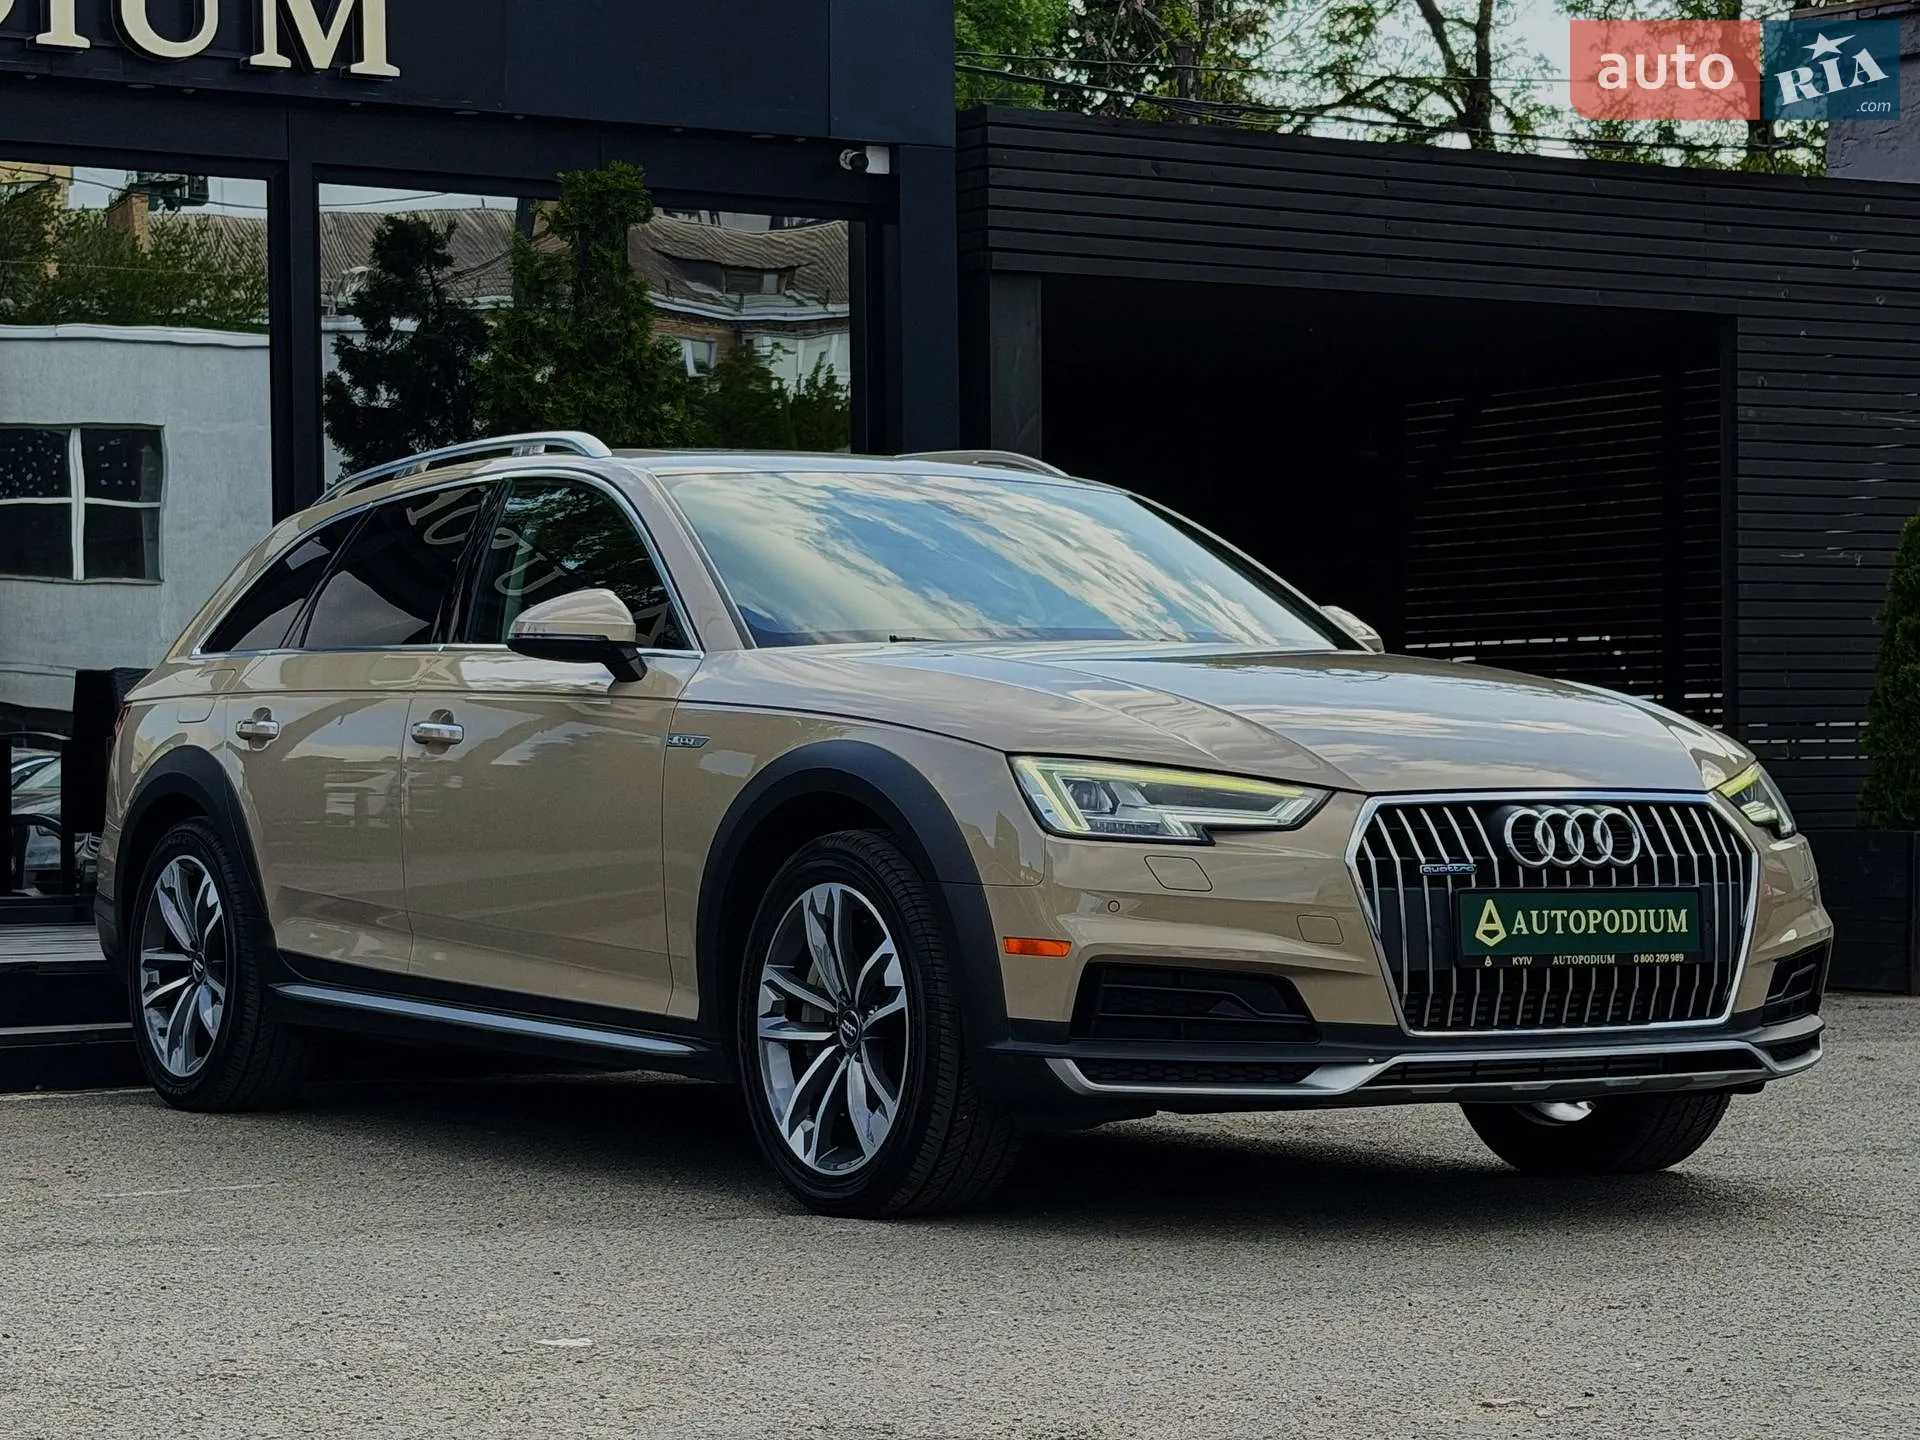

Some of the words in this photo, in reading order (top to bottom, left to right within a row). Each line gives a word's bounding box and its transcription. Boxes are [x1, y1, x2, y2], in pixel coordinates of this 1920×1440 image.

[1511, 908, 1688, 935] AUTOPODIUM
[1512, 956, 1533, 966] KYIV
[1552, 954, 1616, 965] AUTOPODIUM
